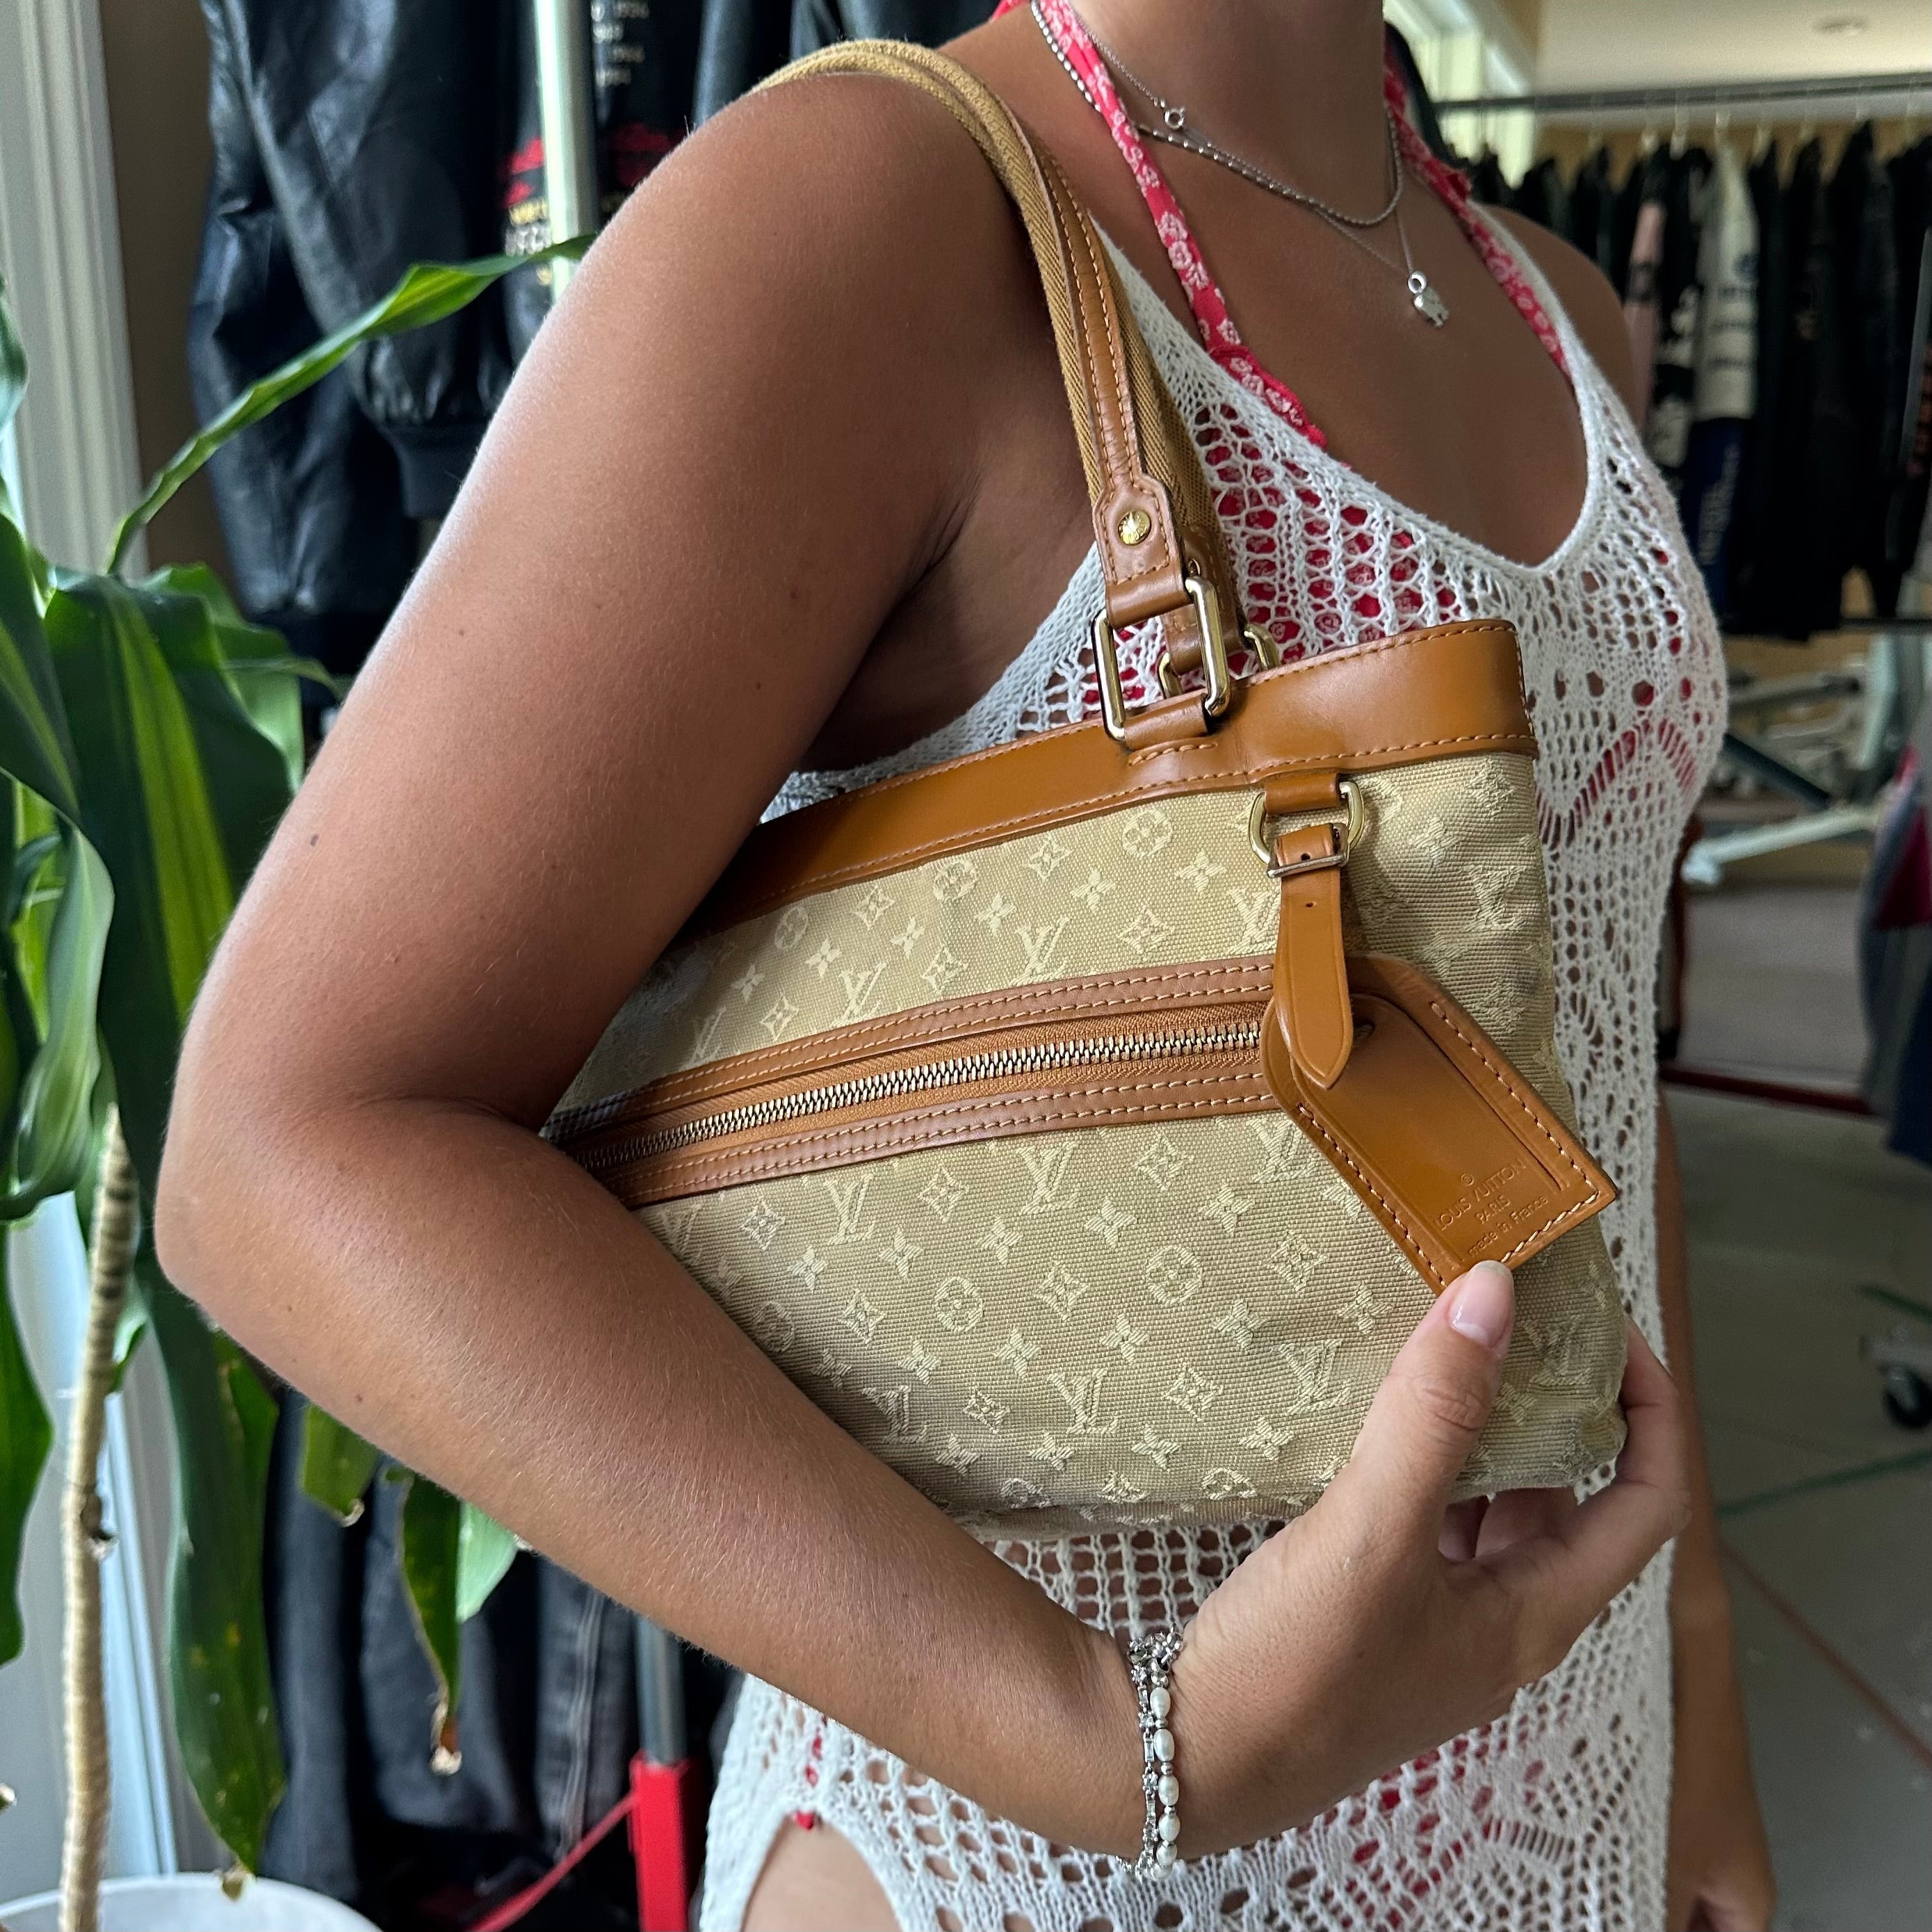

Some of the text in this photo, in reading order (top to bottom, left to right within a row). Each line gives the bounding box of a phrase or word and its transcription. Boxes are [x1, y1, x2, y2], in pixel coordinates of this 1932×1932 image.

[1012, 917, 1069, 987] LV
[831, 961, 888, 1028] LV
[822, 1174, 877, 1247] LV
[1015, 1140, 1082, 1216] LV
[1475, 1194, 1511, 1224] PARIS
[1436, 1196, 1472, 1231] LOUIS
[1468, 1195, 1548, 1258] made in France
[1045, 1367, 1121, 1436] LV
[1274, 1337, 1352, 1416] LV
